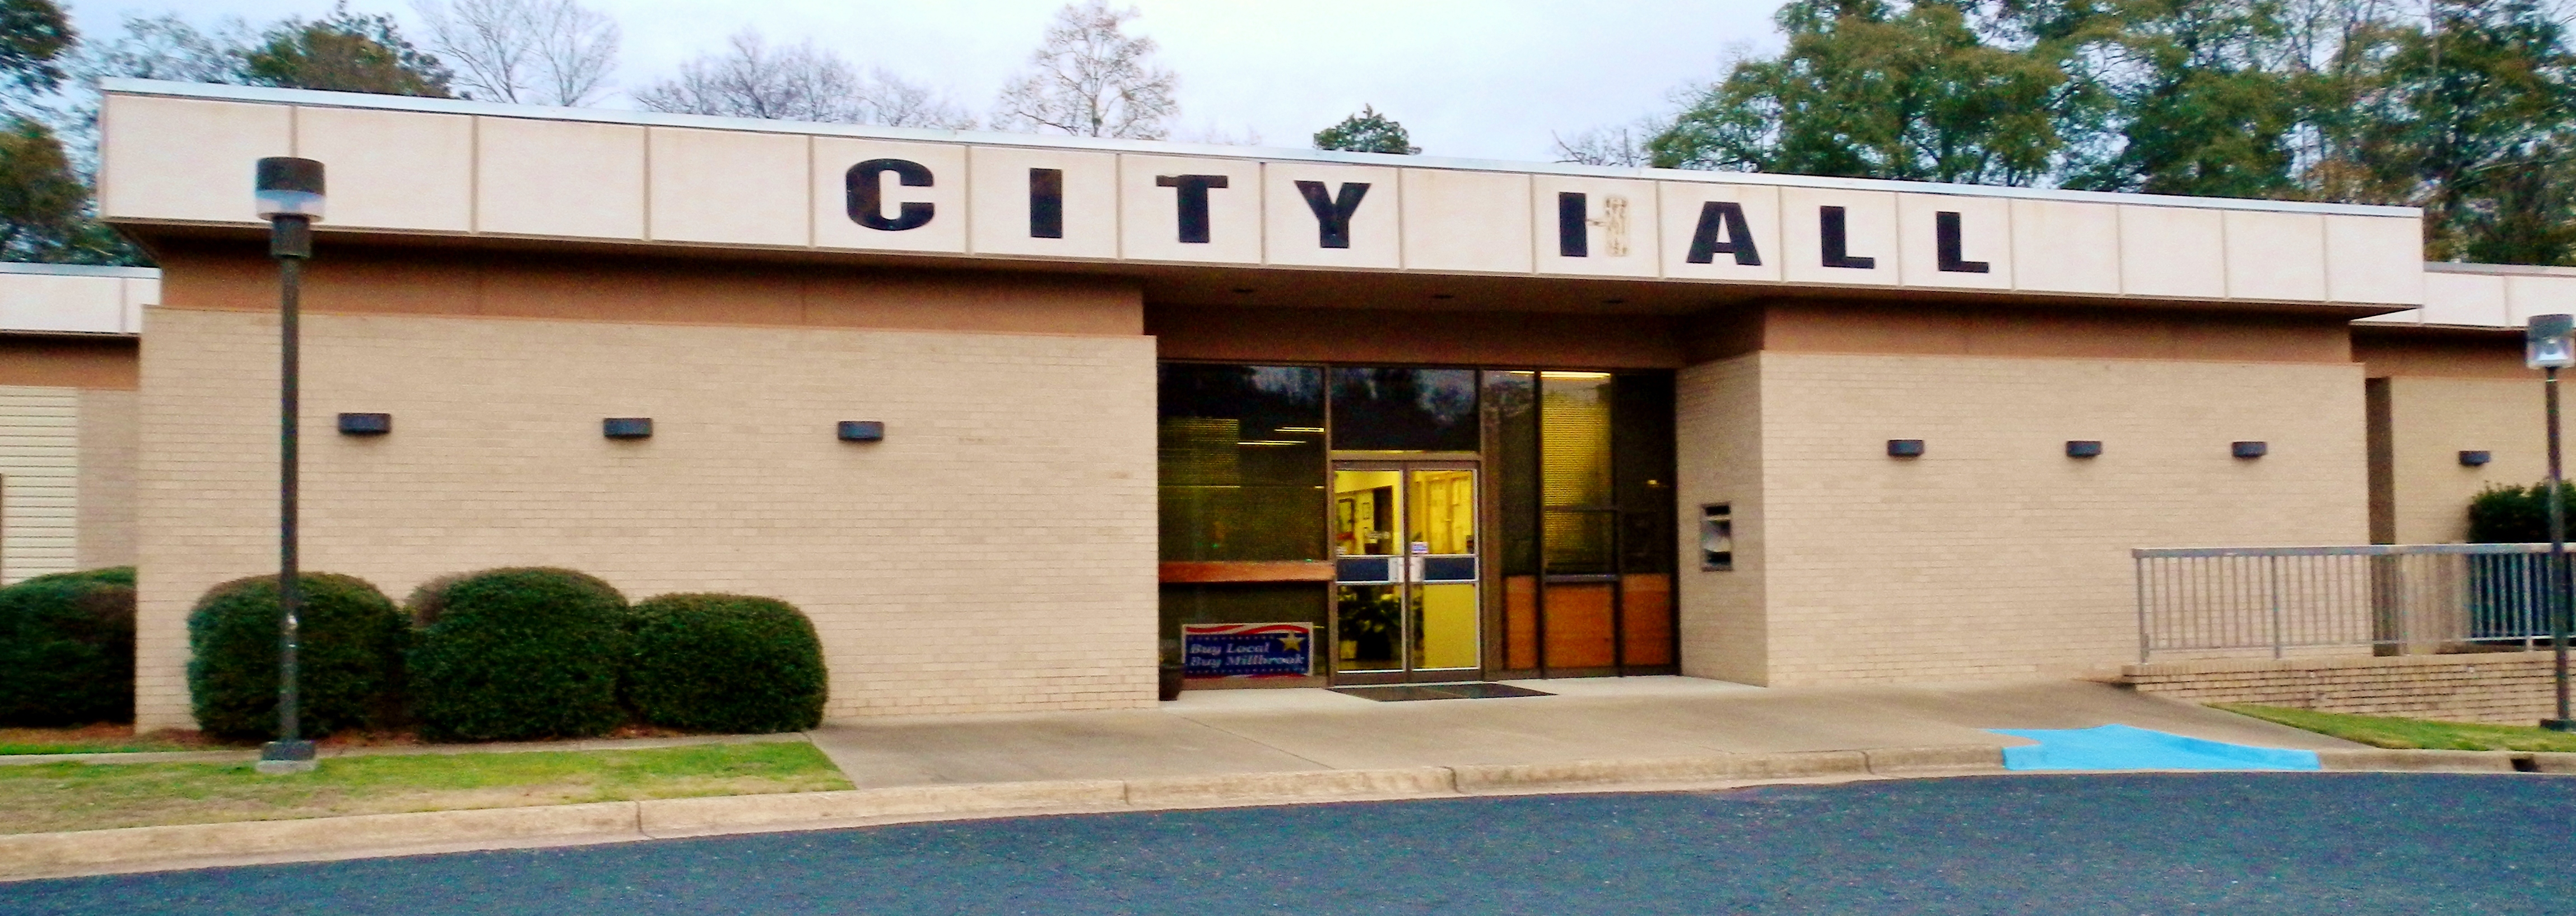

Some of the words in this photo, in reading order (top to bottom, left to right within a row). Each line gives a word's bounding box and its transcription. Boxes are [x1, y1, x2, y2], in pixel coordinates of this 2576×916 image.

[845, 158, 1372, 249] CITY
[1190, 644, 1222, 655] Buy
[1227, 642, 1270, 653] Local
[1191, 657, 1222, 668] Buy
[1226, 654, 1304, 666] Millbrook
